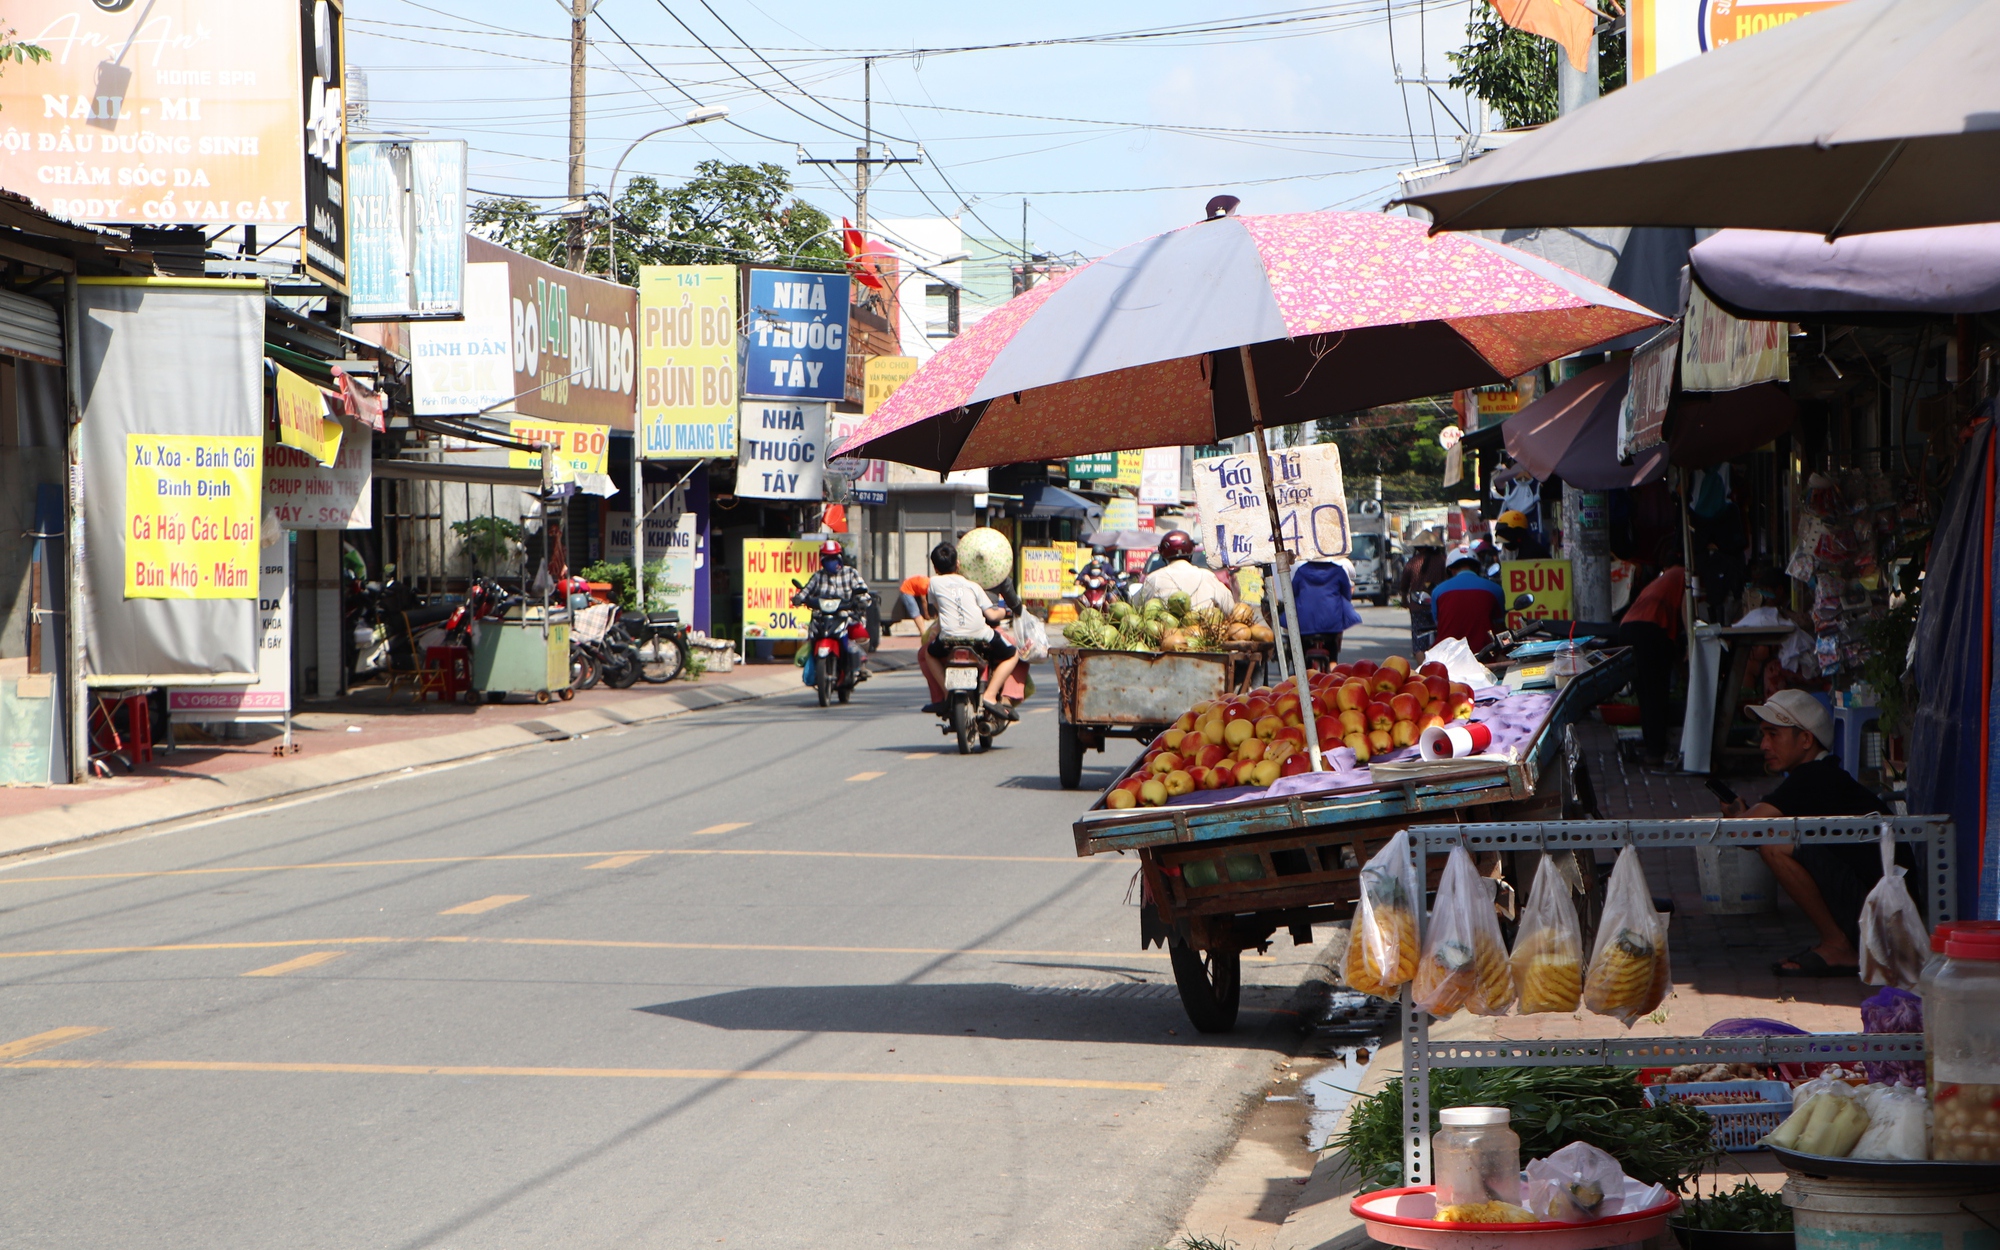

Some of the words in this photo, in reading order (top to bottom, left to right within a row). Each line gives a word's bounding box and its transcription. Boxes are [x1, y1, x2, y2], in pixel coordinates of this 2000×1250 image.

[156, 69, 211, 86] HOME
[218, 70, 256, 86] SPA
[43, 94, 132, 120] NAIL
[160, 96, 202, 121] MI
[0, 127, 31, 156] ỘI
[38, 125, 93, 152] ĐẦU
[101, 131, 192, 155] DƯỠNG
[197, 135, 259, 155] SINH
[37, 161, 110, 185] CHĂM
[117, 163, 166, 187] SÓC
[174, 168, 210, 187] DA
[52, 198, 122, 218] BODY
[142, 190, 177, 219] CỔ
[185, 200, 229, 219] VAI
[235, 194, 290, 219] GÁY
[352, 185, 399, 229] NHÀ
[414, 176, 456, 227] ĐẤT
[676, 273, 701, 287] 141
[773, 277, 827, 310] NHÀ
[646, 292, 694, 347] PHỞ
[700, 296, 732, 347] BÒ
[755, 313, 843, 350] THUỐC
[417, 339, 461, 357] BÌNH
[467, 338, 507, 355] DÂN
[513, 284, 540, 378] BÒ
[537, 276, 569, 359] 141
[570, 303, 608, 390] BÚN
[609, 312, 635, 395] BÒ
[429, 360, 498, 393] 25K
[646, 358, 694, 407] BÚN
[702, 356, 734, 407] BÒ
[770, 353, 824, 388] TÂY
[868, 384, 880, 398] D
[762, 407, 805, 430] NHÀ
[573, 427, 606, 455] BÒ
[647, 414, 671, 451] LẨU
[675, 424, 714, 450] MANG
[718, 415, 734, 450] VỀ
[135, 445, 151, 466] Xu
[157, 446, 181, 467] Xoa
[196, 447, 229, 467] Bánh
[234, 447, 255, 467] Gói
[749, 436, 815, 463] THUỐC
[158, 479, 191, 496] Bình
[197, 480, 231, 500] Định
[269, 478, 302, 497] CHỤP
[305, 476, 333, 495] HÌNH
[337, 475, 359, 496] THẺ
[762, 469, 800, 493] TÂY
[133, 514, 151, 540] Cá
[157, 513, 185, 545] Hấp
[191, 515, 218, 541] Các
[223, 516, 254, 546] Loại
[648, 531, 690, 547] KHANG
[1269, 504, 1347, 557] 40
[265, 566, 283, 575] SPA
[748, 542, 767, 573] HỦ
[772, 541, 802, 573] TIẾU
[136, 561, 164, 587] Bún
[170, 562, 198, 587] Khô
[214, 558, 248, 587] Mắm
[1048, 569, 1061, 583] XE
[1510, 563, 1564, 593] BÚN
[747, 581, 772, 609] BÁNH
[775, 581, 786, 609] MÌ
[769, 612, 797, 629] 30k
[268, 635, 282, 649] GÁY
[191, 694, 281, 706] 0962.915.272
